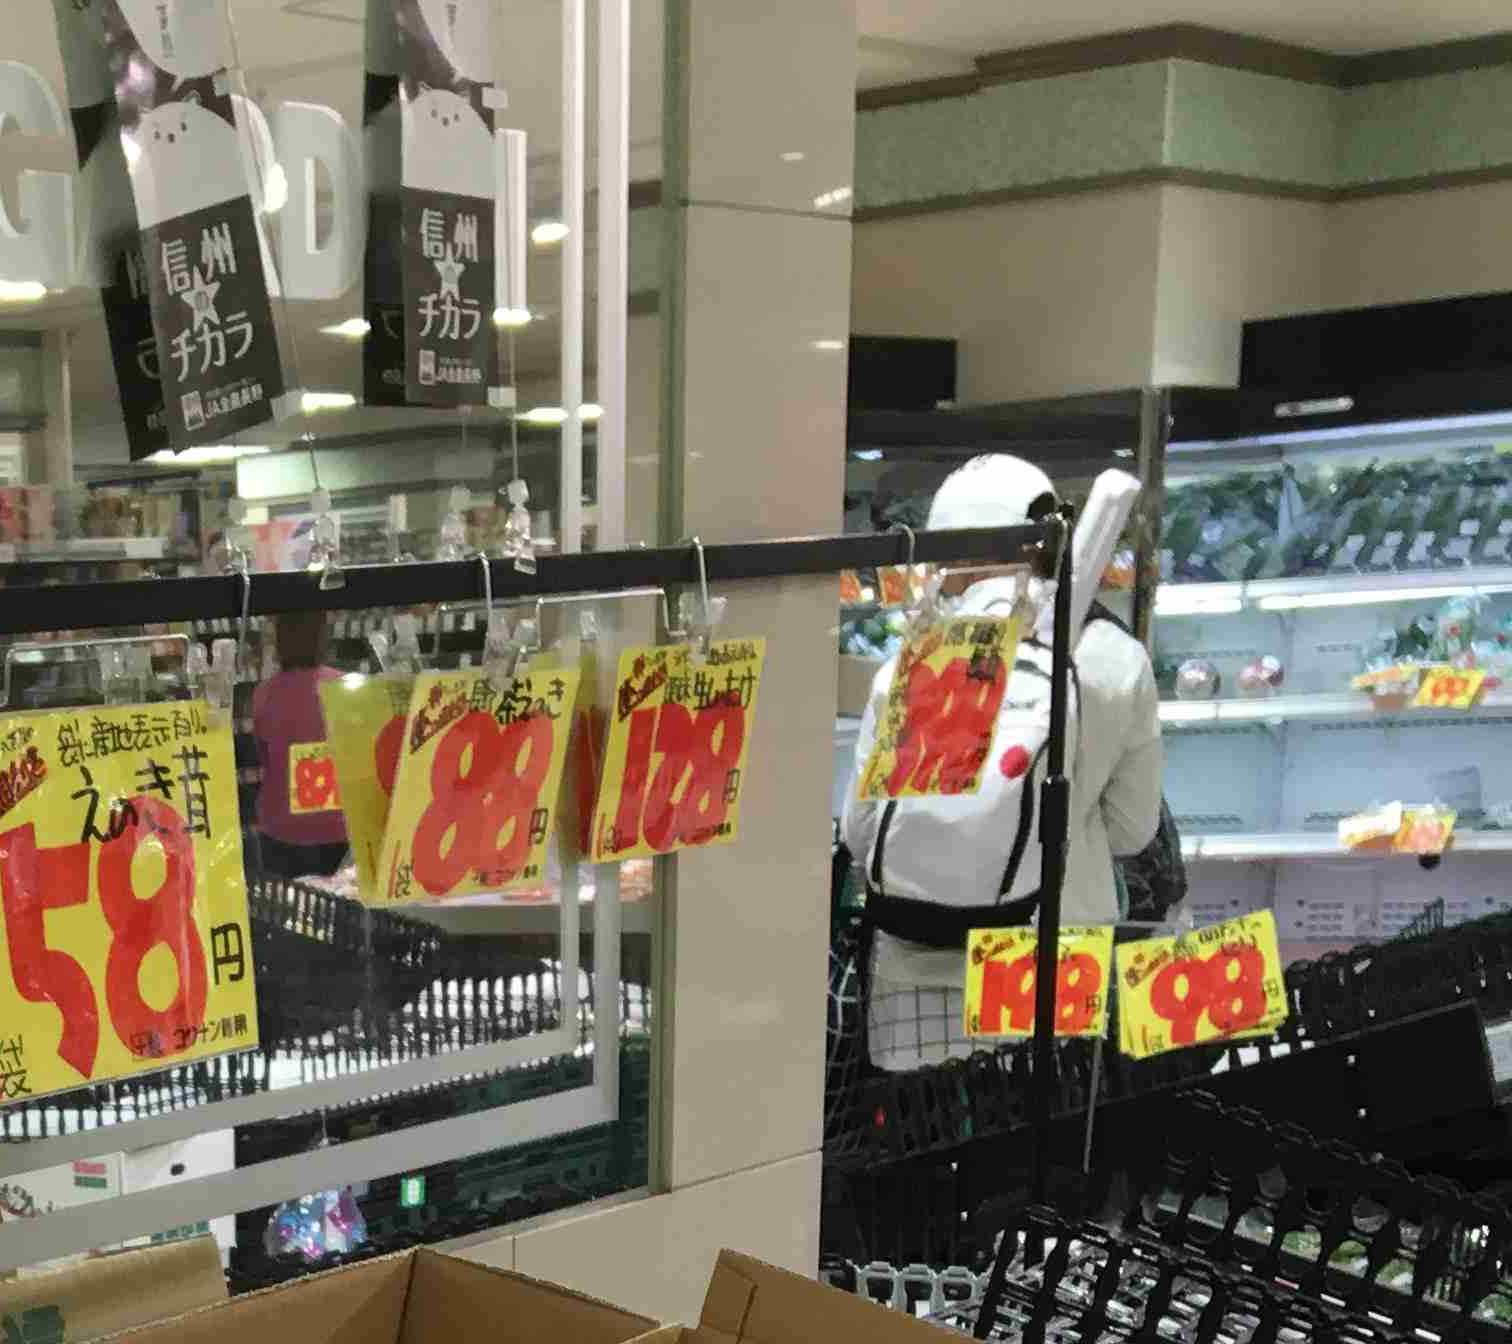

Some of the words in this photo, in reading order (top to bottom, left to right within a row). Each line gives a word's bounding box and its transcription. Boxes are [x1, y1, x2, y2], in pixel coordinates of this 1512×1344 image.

[161, 221, 237, 297] 信州
[420, 208, 478, 263] 信州
[169, 311, 253, 382] チカラ
[417, 293, 481, 340] チカラ
[412, 711, 553, 895] 88
[210, 922, 244, 985] 円
[1150, 944, 1267, 1045] 98
